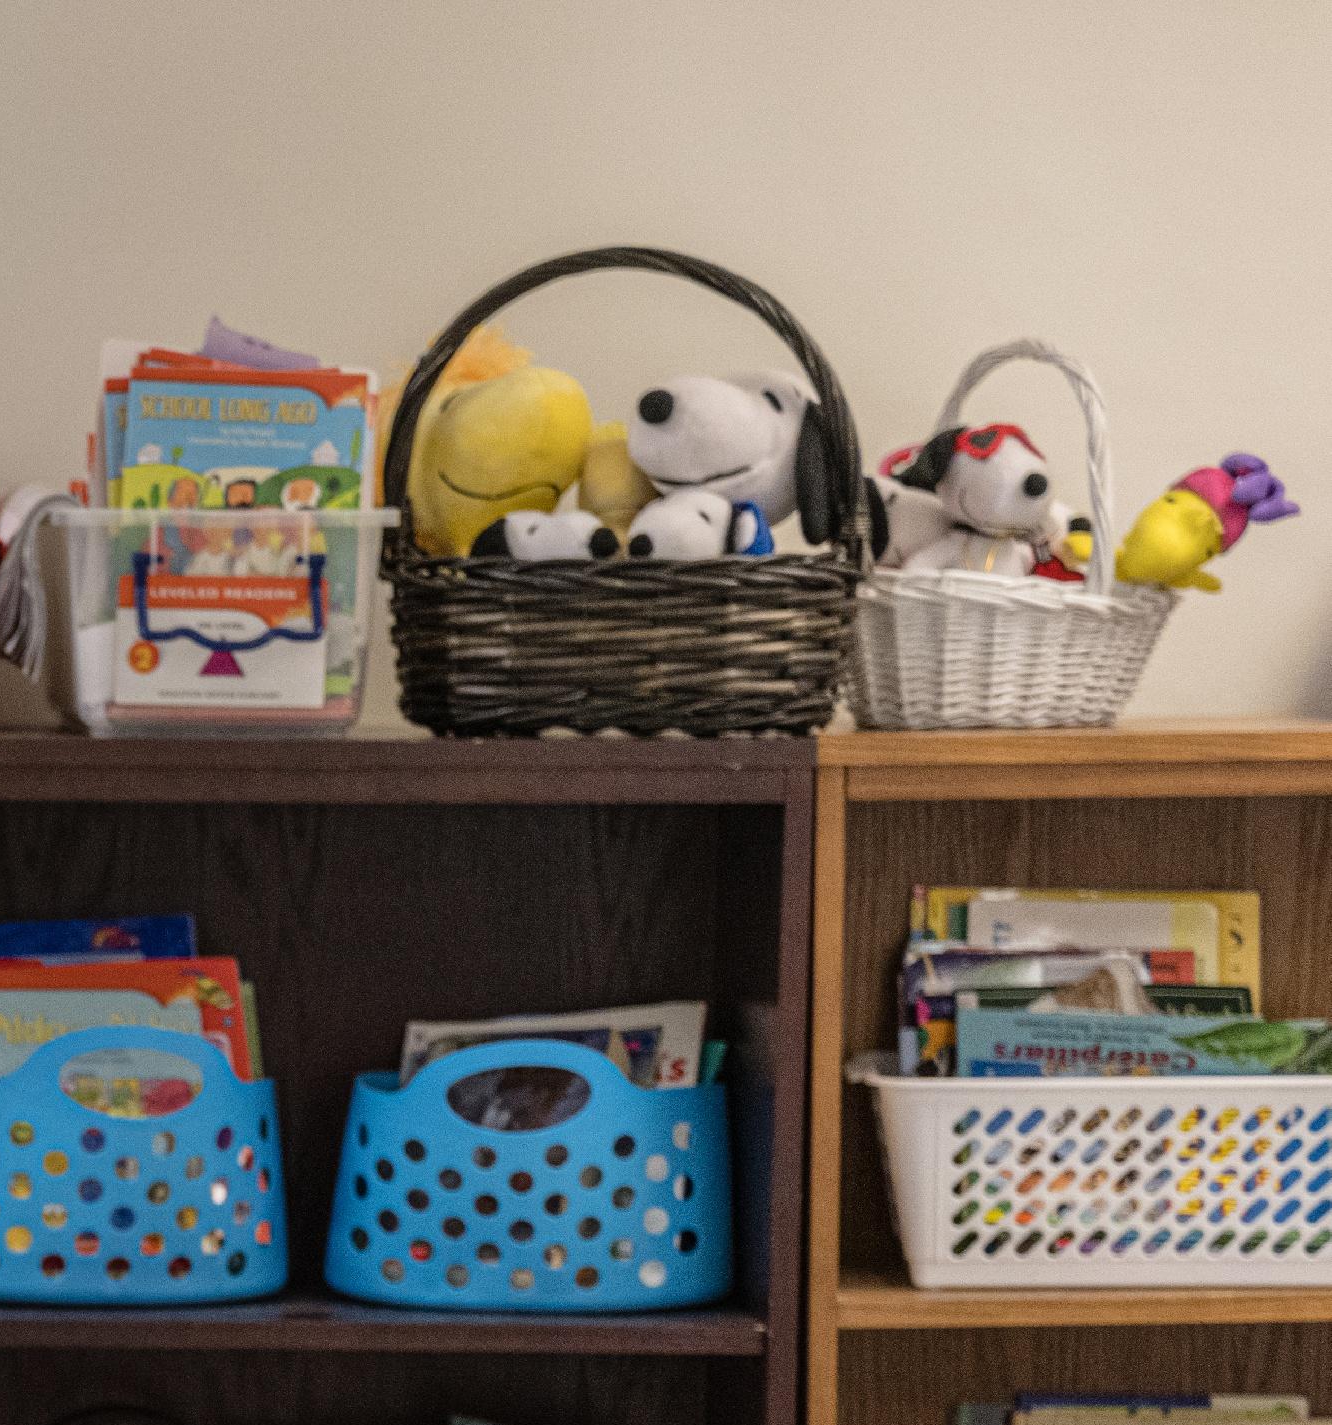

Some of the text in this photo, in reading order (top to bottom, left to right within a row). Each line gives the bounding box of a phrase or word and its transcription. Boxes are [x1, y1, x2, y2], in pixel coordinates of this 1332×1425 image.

[140, 394, 317, 425] SCHOOL LONG AGO
[150, 586, 297, 601] LEVELED READERS
[993, 1043, 1197, 1073] Caterpillars
